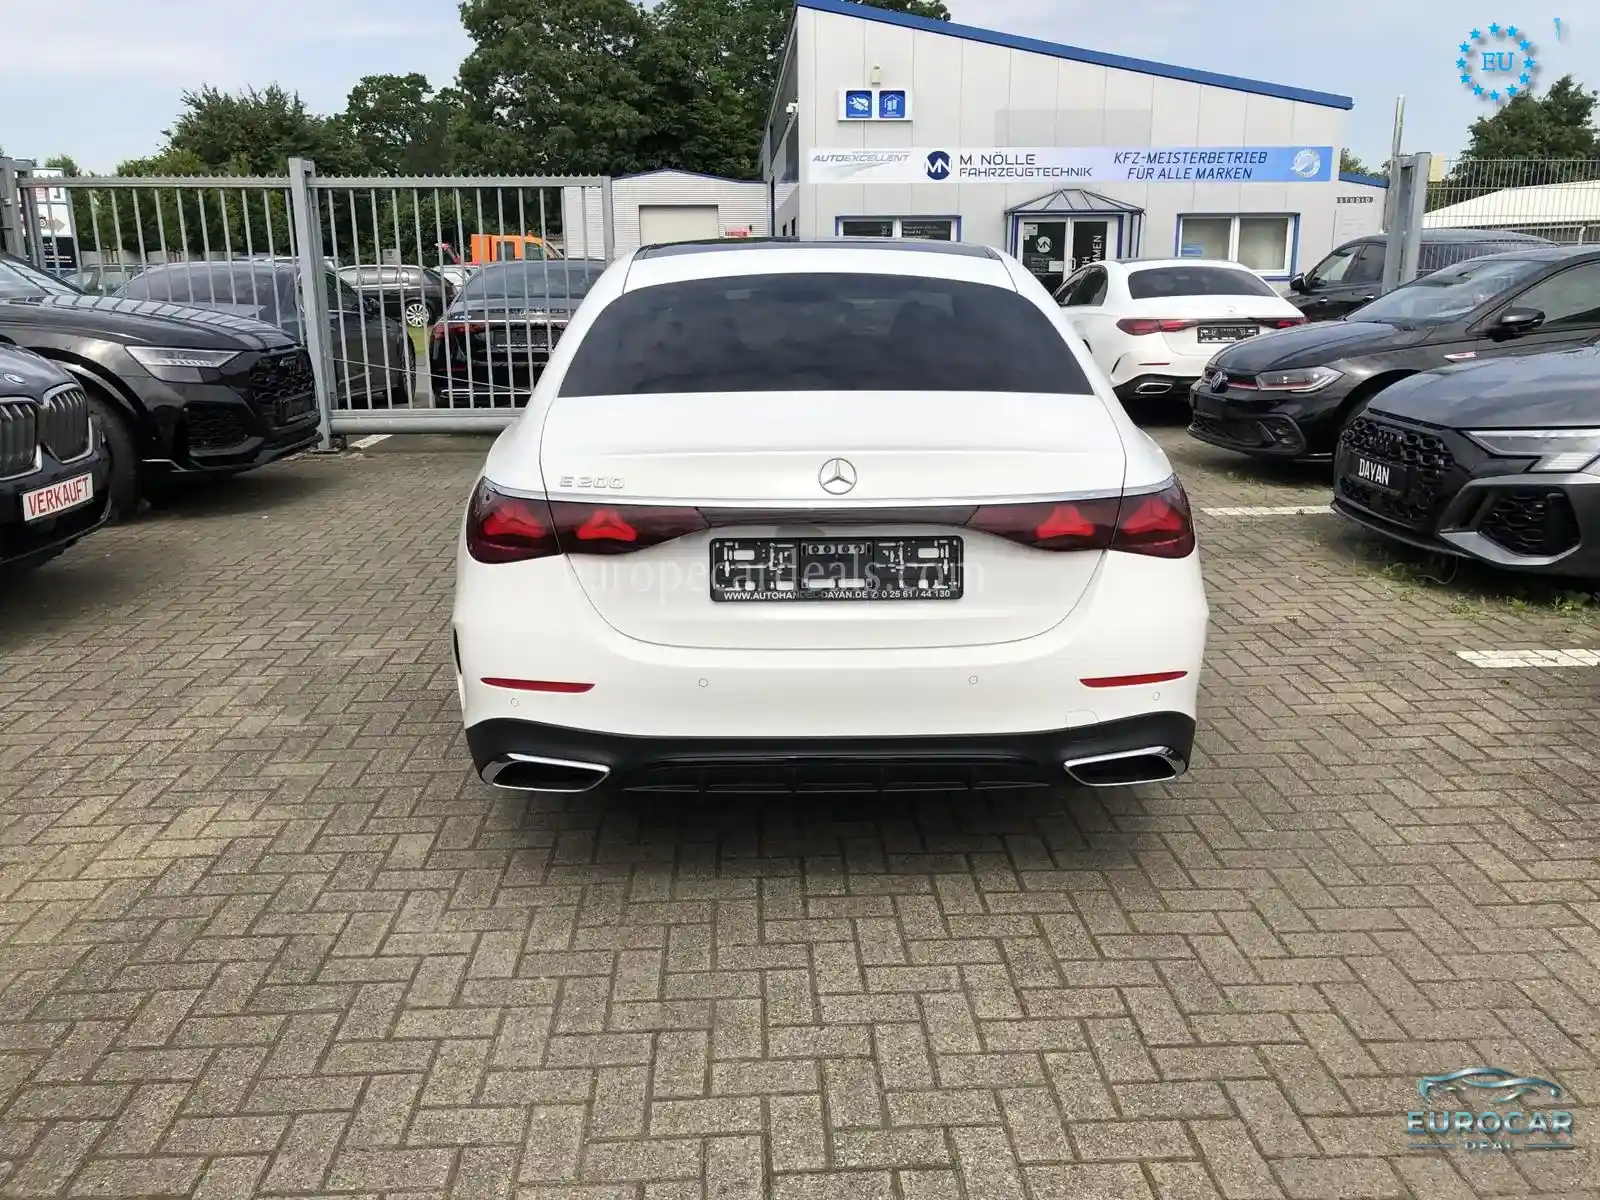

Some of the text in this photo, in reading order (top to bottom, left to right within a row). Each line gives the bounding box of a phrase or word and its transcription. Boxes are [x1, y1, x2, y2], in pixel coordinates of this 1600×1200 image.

[813, 154, 910, 162] AUTOEXCELLENT
[959, 152, 1036, 166] M. NÖLLE
[1113, 151, 1268, 165] KFZ-MEISTERBETRIEB
[959, 167, 1093, 178] FAHRZEUGTECHNIK
[1127, 164, 1253, 180] FÜR ALLE MARKEN
[1358, 457, 1390, 486] DAYAN
[559, 475, 625, 489] E 200
[27, 476, 89, 516] VERKAUFT
[920, 590, 932, 599] 44
[934, 590, 951, 599] 130
